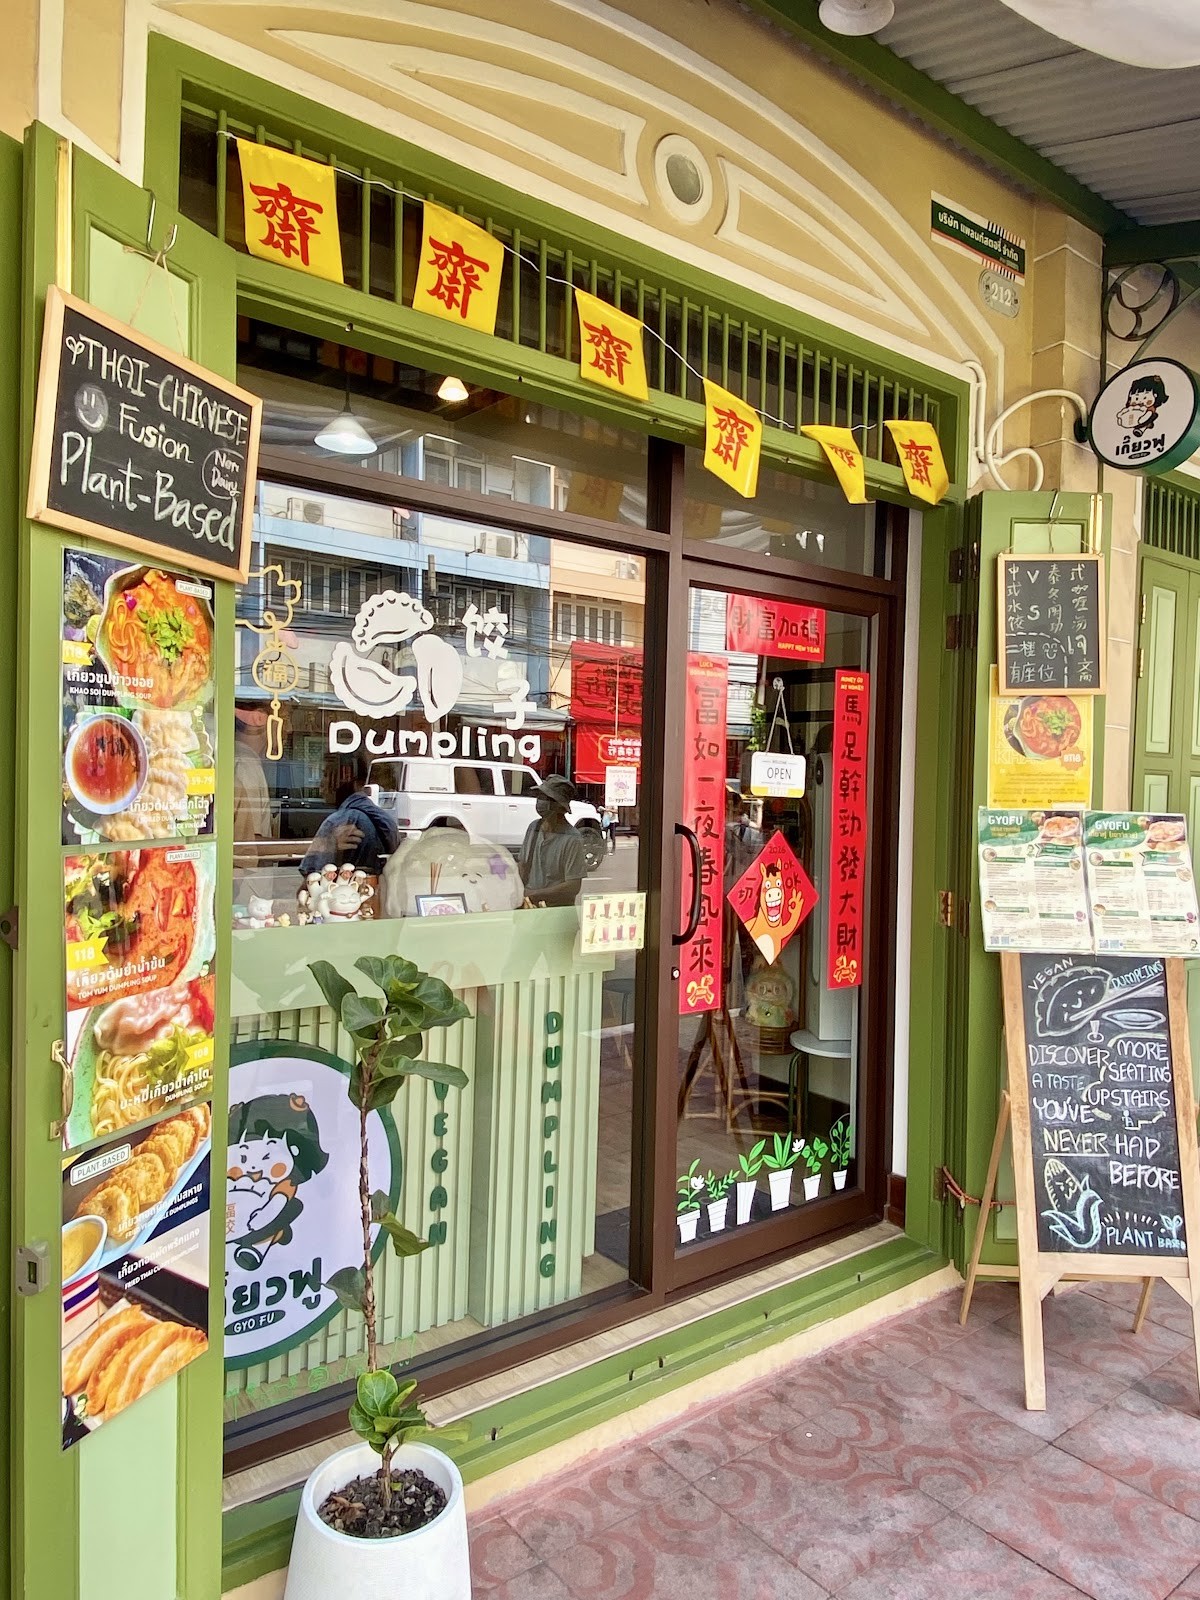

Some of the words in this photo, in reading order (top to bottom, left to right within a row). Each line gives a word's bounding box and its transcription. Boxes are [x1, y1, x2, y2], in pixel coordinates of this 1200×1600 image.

[938, 211, 959, 230] บริษัท
[991, 282, 1012, 307] 212
[79, 333, 248, 446] THAI-CHINESE
[119, 402, 194, 464] Fusion
[60, 431, 237, 553] Plant-Based
[211, 467, 241, 497] Dairy
[180, 584, 209, 597] PLANT-BASED
[1007, 563, 1025, 632] 中式水饺
[777, 641, 795, 651] HAPPY
[806, 645, 820, 654] YEAR
[262, 660, 288, 685] 福
[1009, 661, 1056, 684] 有座位
[70, 686, 89, 695] KHAO
[89, 688, 101, 696] SOI
[101, 689, 135, 698] DUMPLING
[136, 692, 152, 700] SOUP
[329, 720, 541, 763] Dumpling
[766, 767, 792, 780] OPEN
[837, 694, 862, 955] 馬足幹勁發大財
[988, 815, 1023, 825] GYOFU
[1094, 820, 1130, 831] GYOFU
[169, 851, 199, 860] PLANT-BASED
[738, 876, 757, 905] 一切
[785, 872, 801, 889] OK
[74, 947, 95, 962] 118
[1028, 956, 1074, 992] VEGAN
[1111, 960, 1164, 990] DUMPLING
[77, 989, 94, 1000] TOM
[93, 986, 108, 997] YUM
[108, 978, 141, 992] DUMPLING
[141, 974, 158, 985] SOUP
[1028, 1043, 1111, 1068] DISCOVER
[1117, 1039, 1169, 1061] MORE
[1032, 1072, 1043, 1089] A
[1048, 1074, 1085, 1090] TASTE
[1108, 1061, 1172, 1083] SEATING
[165, 1086, 193, 1103] DUMPLING
[194, 1080, 208, 1091] SOUP
[1088, 1088, 1171, 1108] UPSTAIRS
[1033, 1096, 1095, 1123] YOU'VE
[539, 1011, 563, 1278] DUMPLING
[1043, 1127, 1110, 1155] NEVER
[1115, 1133, 1161, 1160] HAD
[77, 1151, 126, 1178] PLANT-BASED
[429, 1080, 450, 1248] VEGAN
[1109, 1160, 1180, 1193] BEFORE
[169, 1195, 198, 1216] DUMPLINGS
[1106, 1226, 1153, 1248] PLANT
[124, 1276, 140, 1291] FRIED
[140, 1269, 153, 1281] THAI
[233, 1317, 257, 1334] GYO
[258, 1311, 275, 1327] FU
